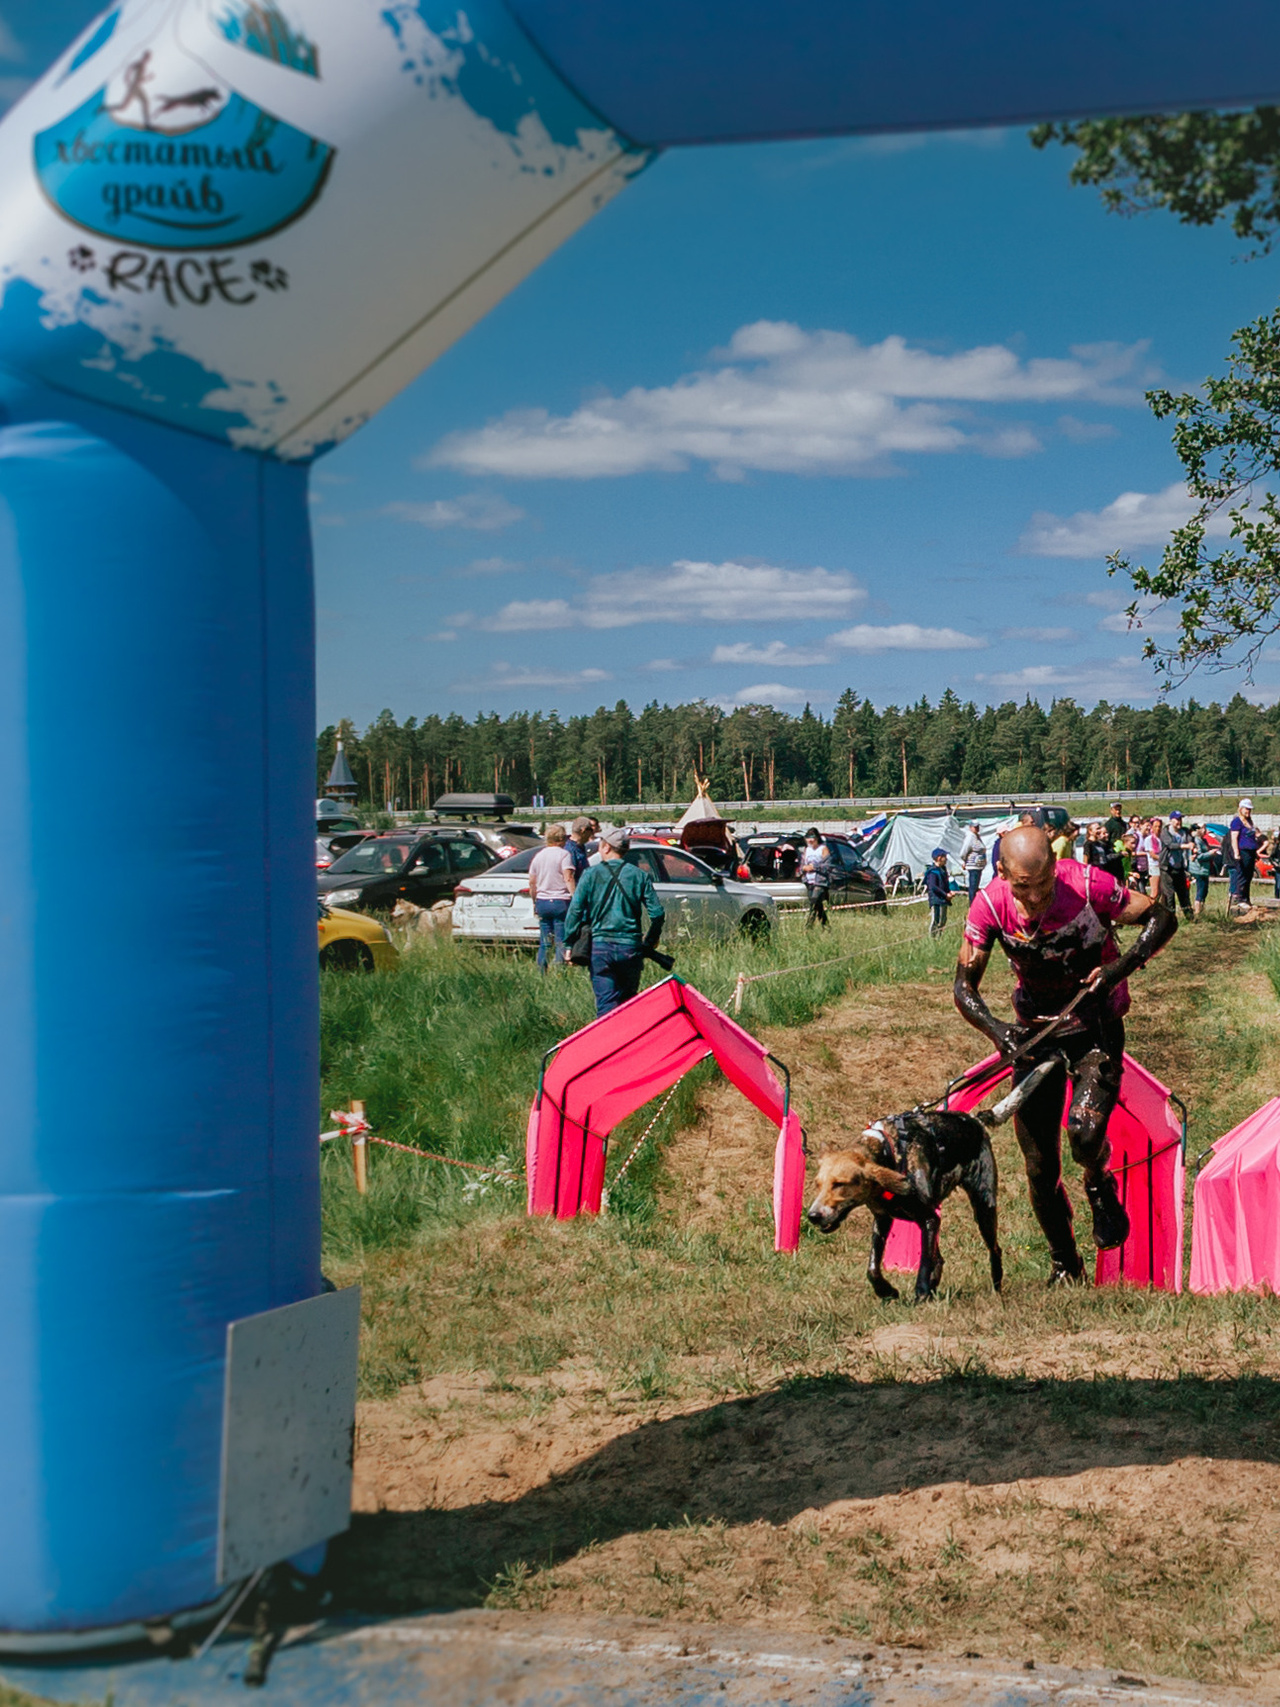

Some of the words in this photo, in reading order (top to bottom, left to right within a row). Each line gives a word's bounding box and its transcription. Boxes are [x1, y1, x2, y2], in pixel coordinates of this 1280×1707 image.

[55, 128, 285, 175] хвостатый
[101, 173, 226, 226] драйв
[104, 252, 258, 308] RACE
